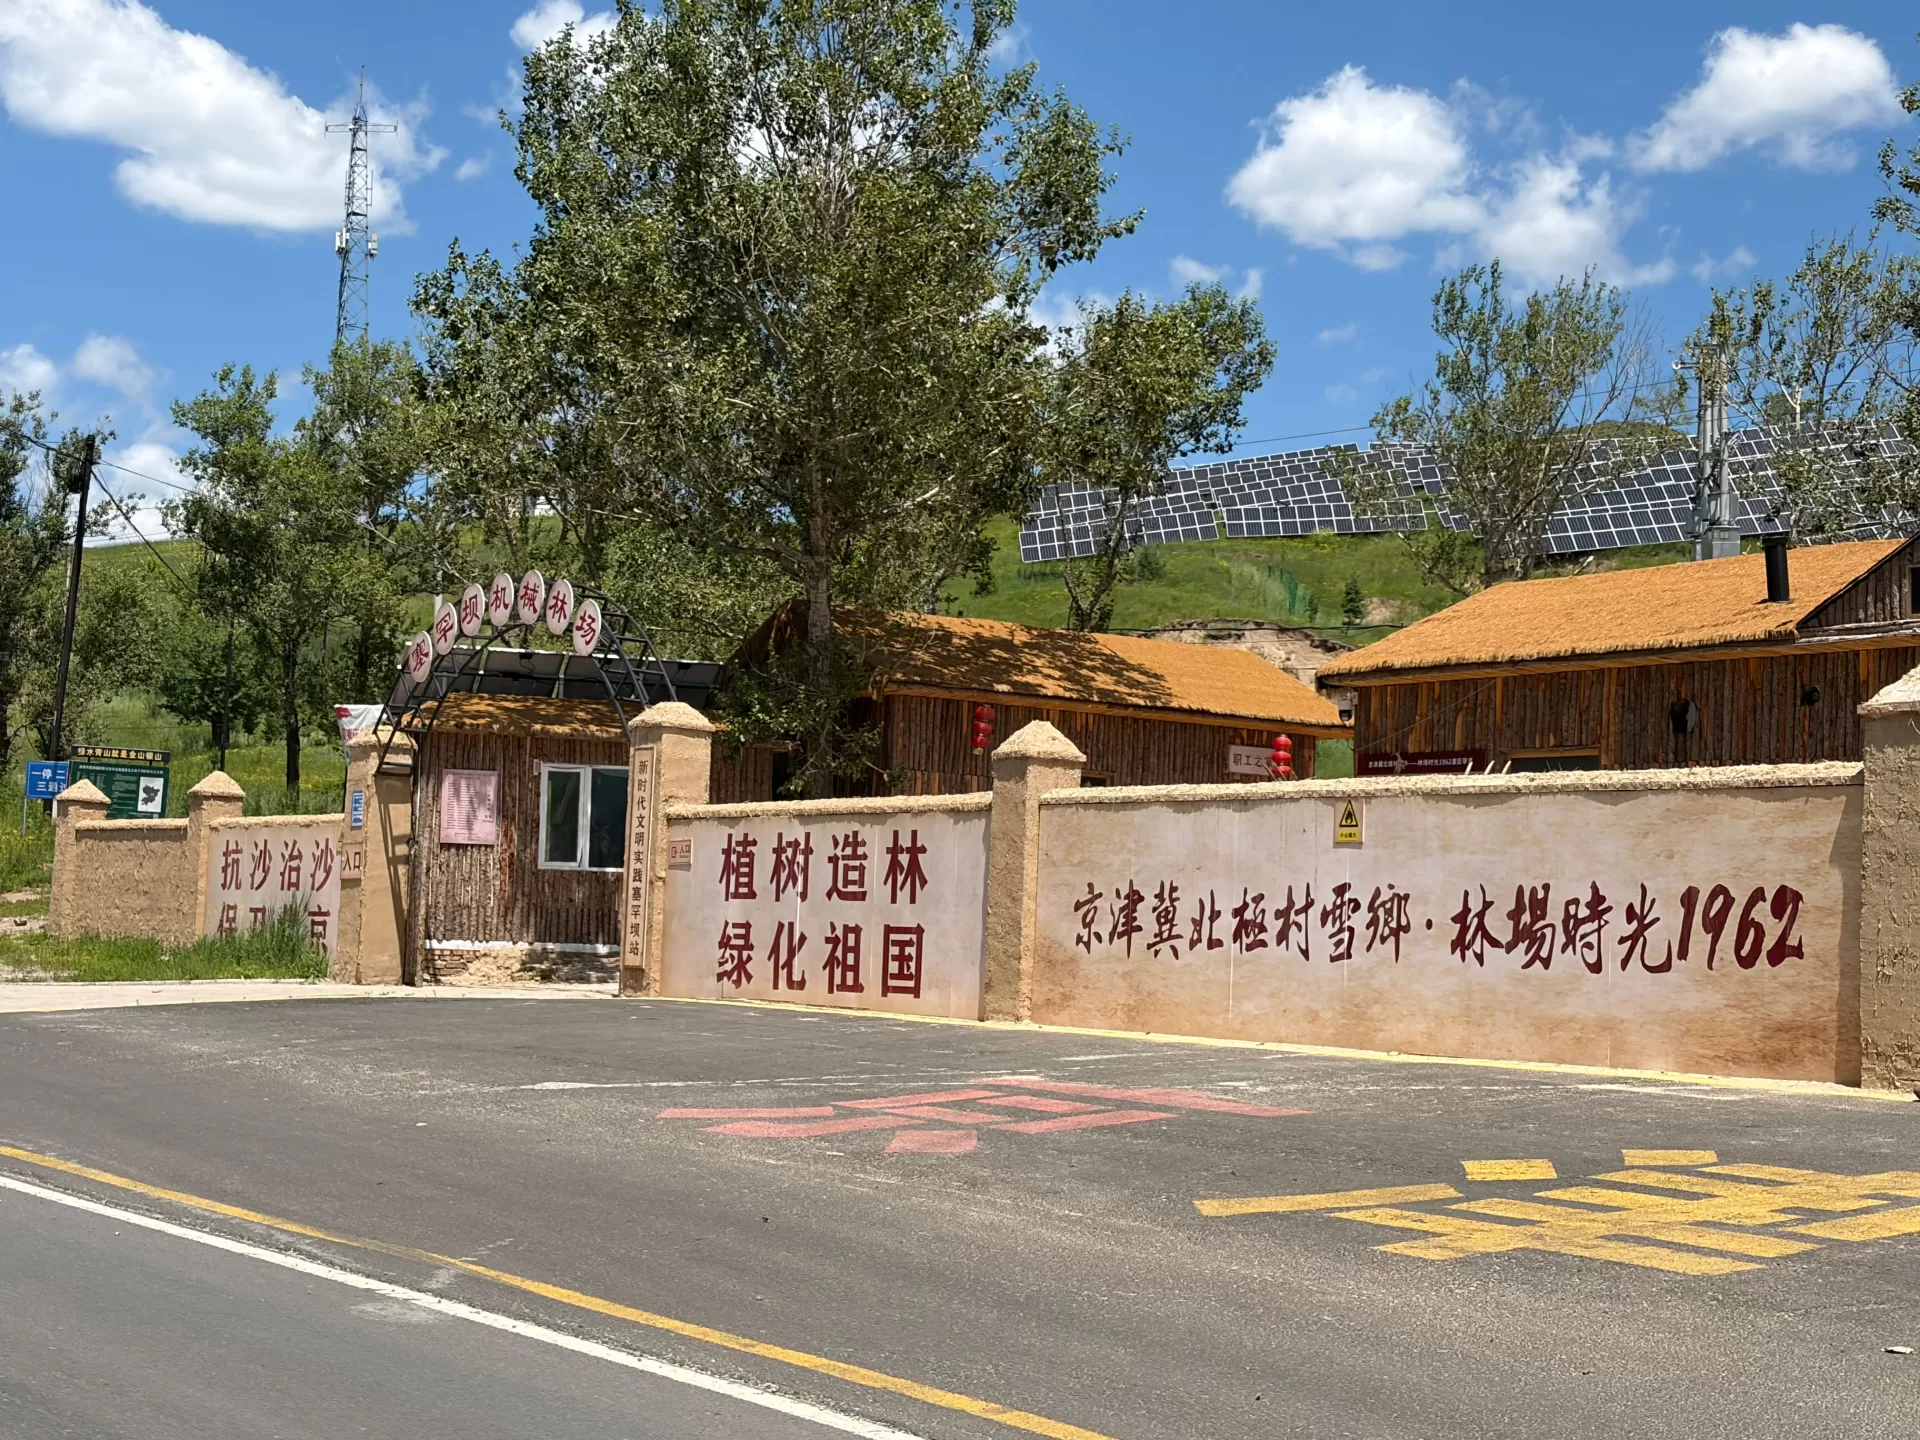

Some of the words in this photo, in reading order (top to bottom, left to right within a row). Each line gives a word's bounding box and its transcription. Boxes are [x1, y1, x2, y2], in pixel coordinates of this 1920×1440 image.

[412, 580, 597, 673] 塞罕坝机械林场
[221, 838, 335, 892] 抗沙治沙
[343, 848, 362, 872] 入口
[629, 759, 649, 956] 新时代文明实践塞罕坝站
[718, 829, 928, 905] 植树造林
[217, 902, 331, 956] 保卫京
[716, 919, 926, 999] 绿化祖国
